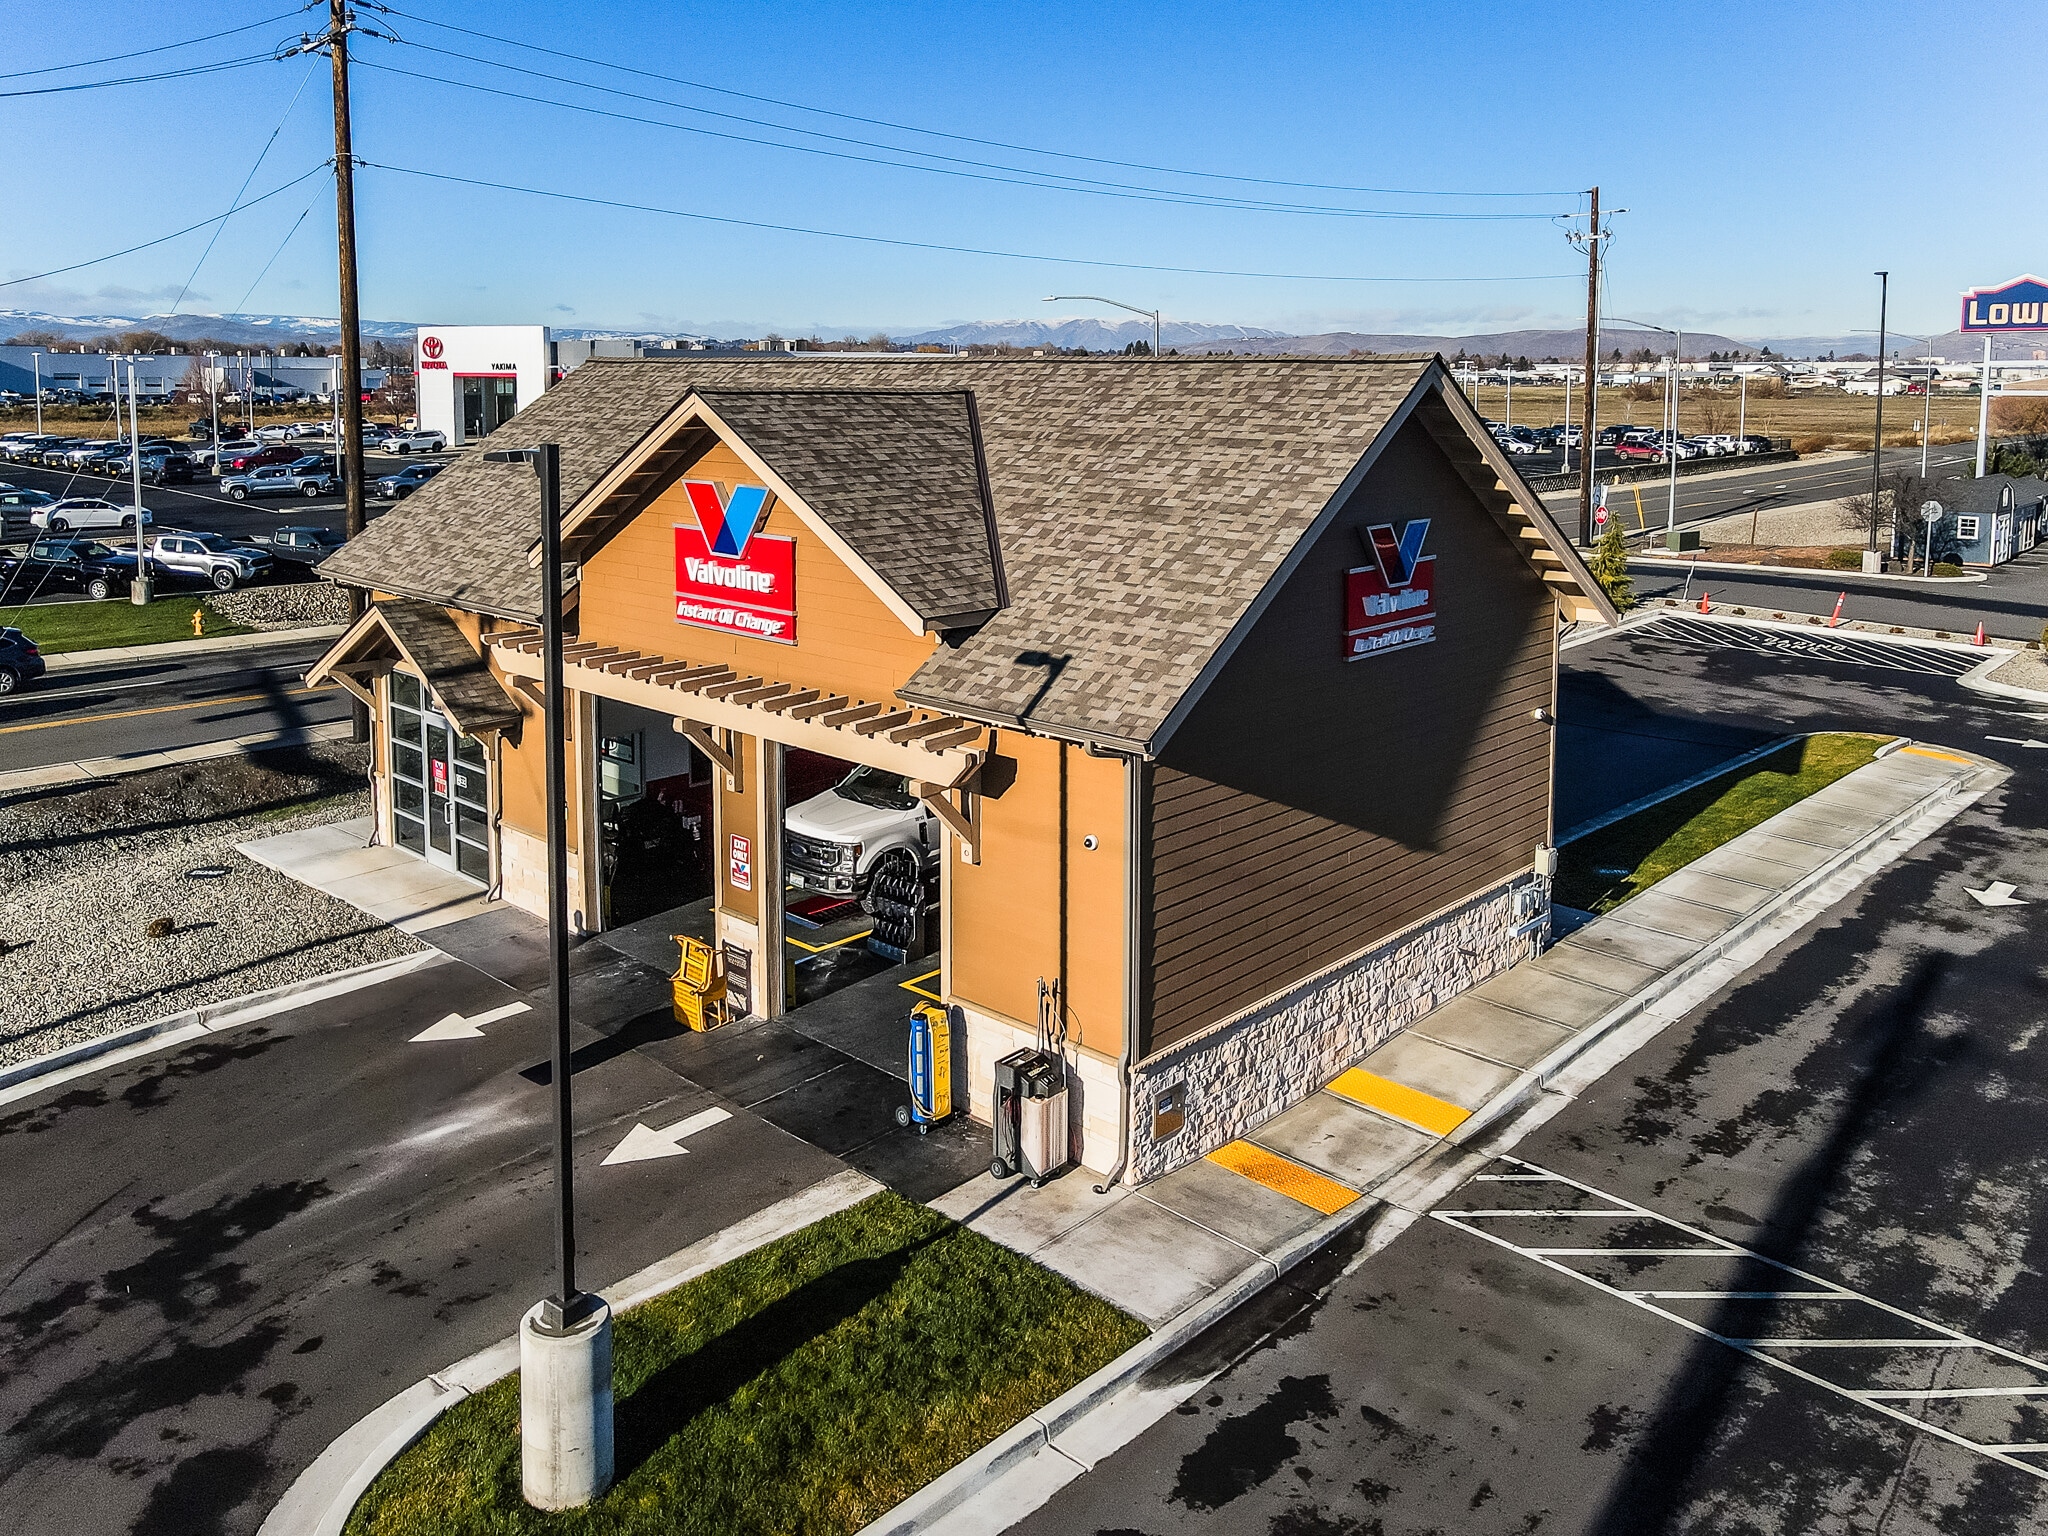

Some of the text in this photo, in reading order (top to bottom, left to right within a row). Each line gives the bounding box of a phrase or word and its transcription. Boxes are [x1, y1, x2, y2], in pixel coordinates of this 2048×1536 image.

[684, 557, 775, 594] Valvoline
[677, 601, 786, 635] Instant Oil Change
